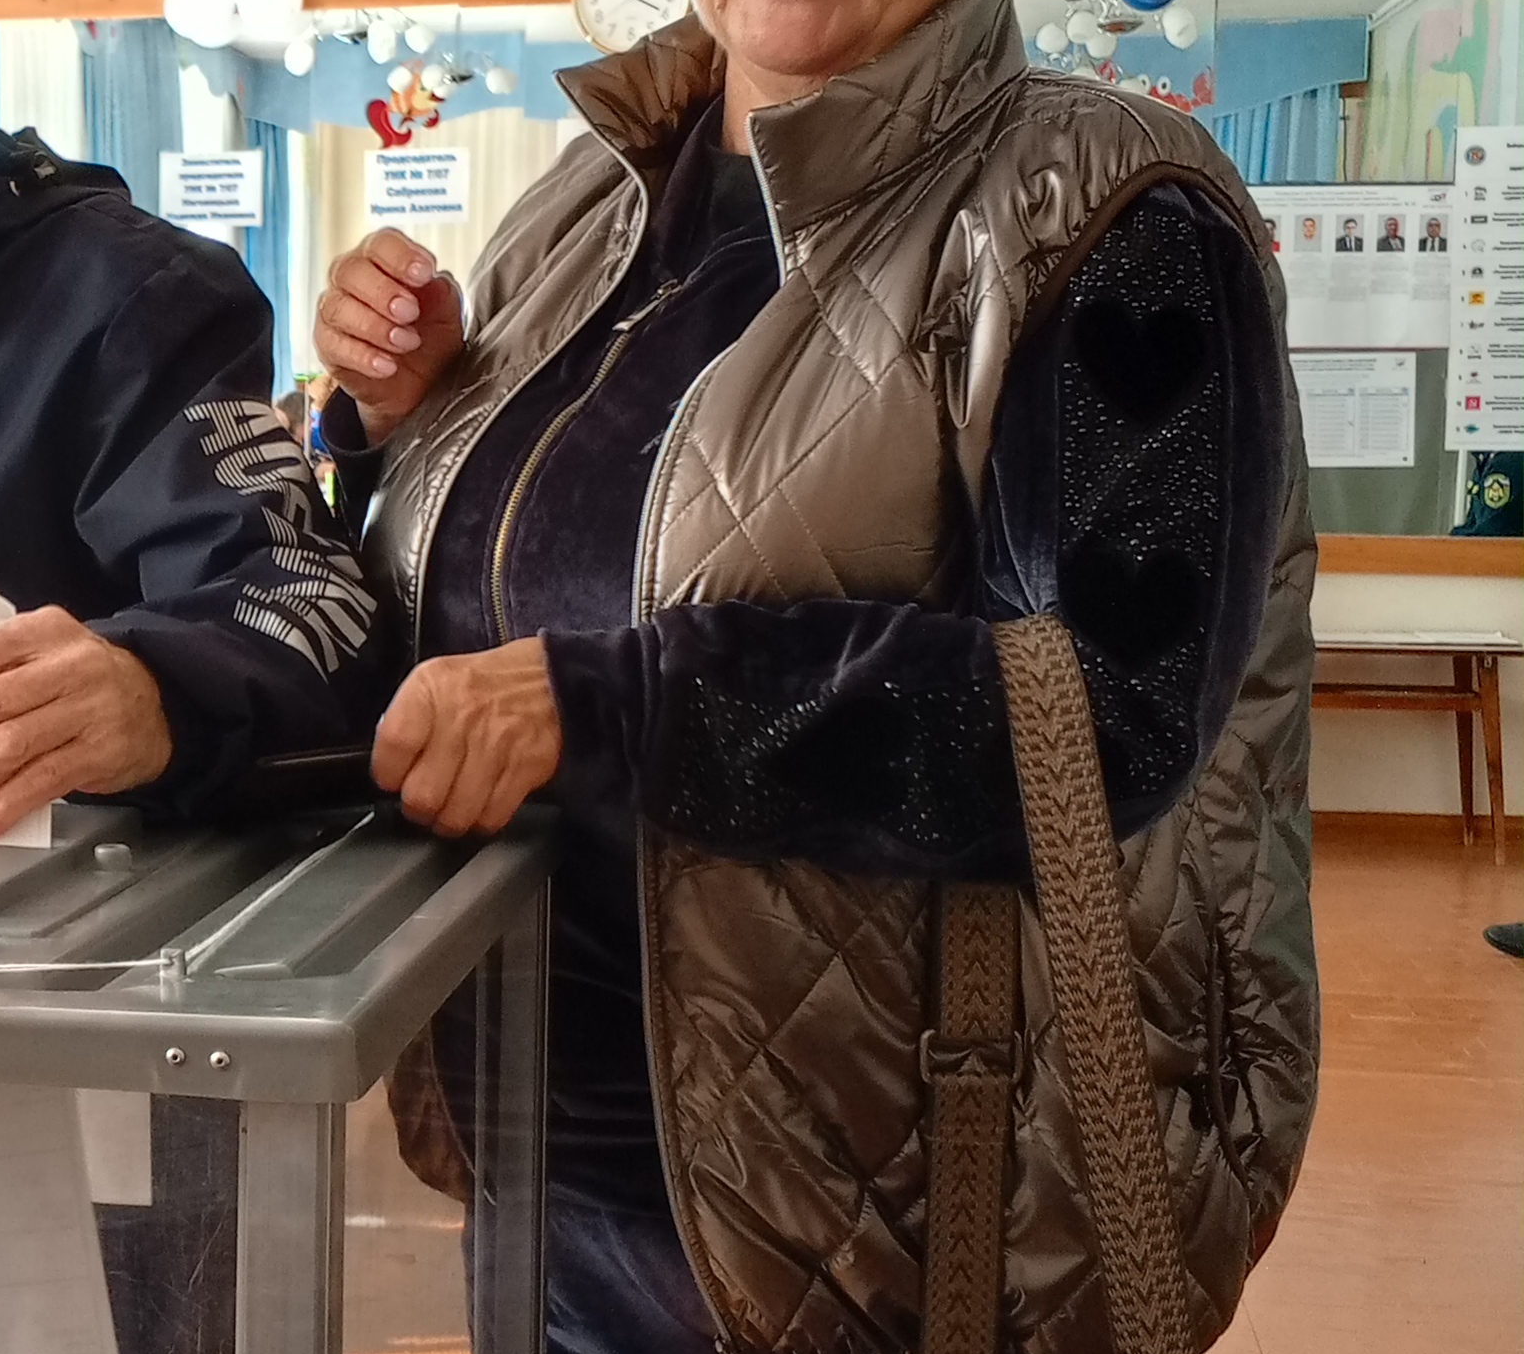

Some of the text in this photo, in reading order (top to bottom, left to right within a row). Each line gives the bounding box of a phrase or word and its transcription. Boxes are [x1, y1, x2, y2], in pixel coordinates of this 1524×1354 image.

[594, 9, 604, 23] 8
[608, 22, 617, 37] 7
[627, 27, 636, 41] 6
